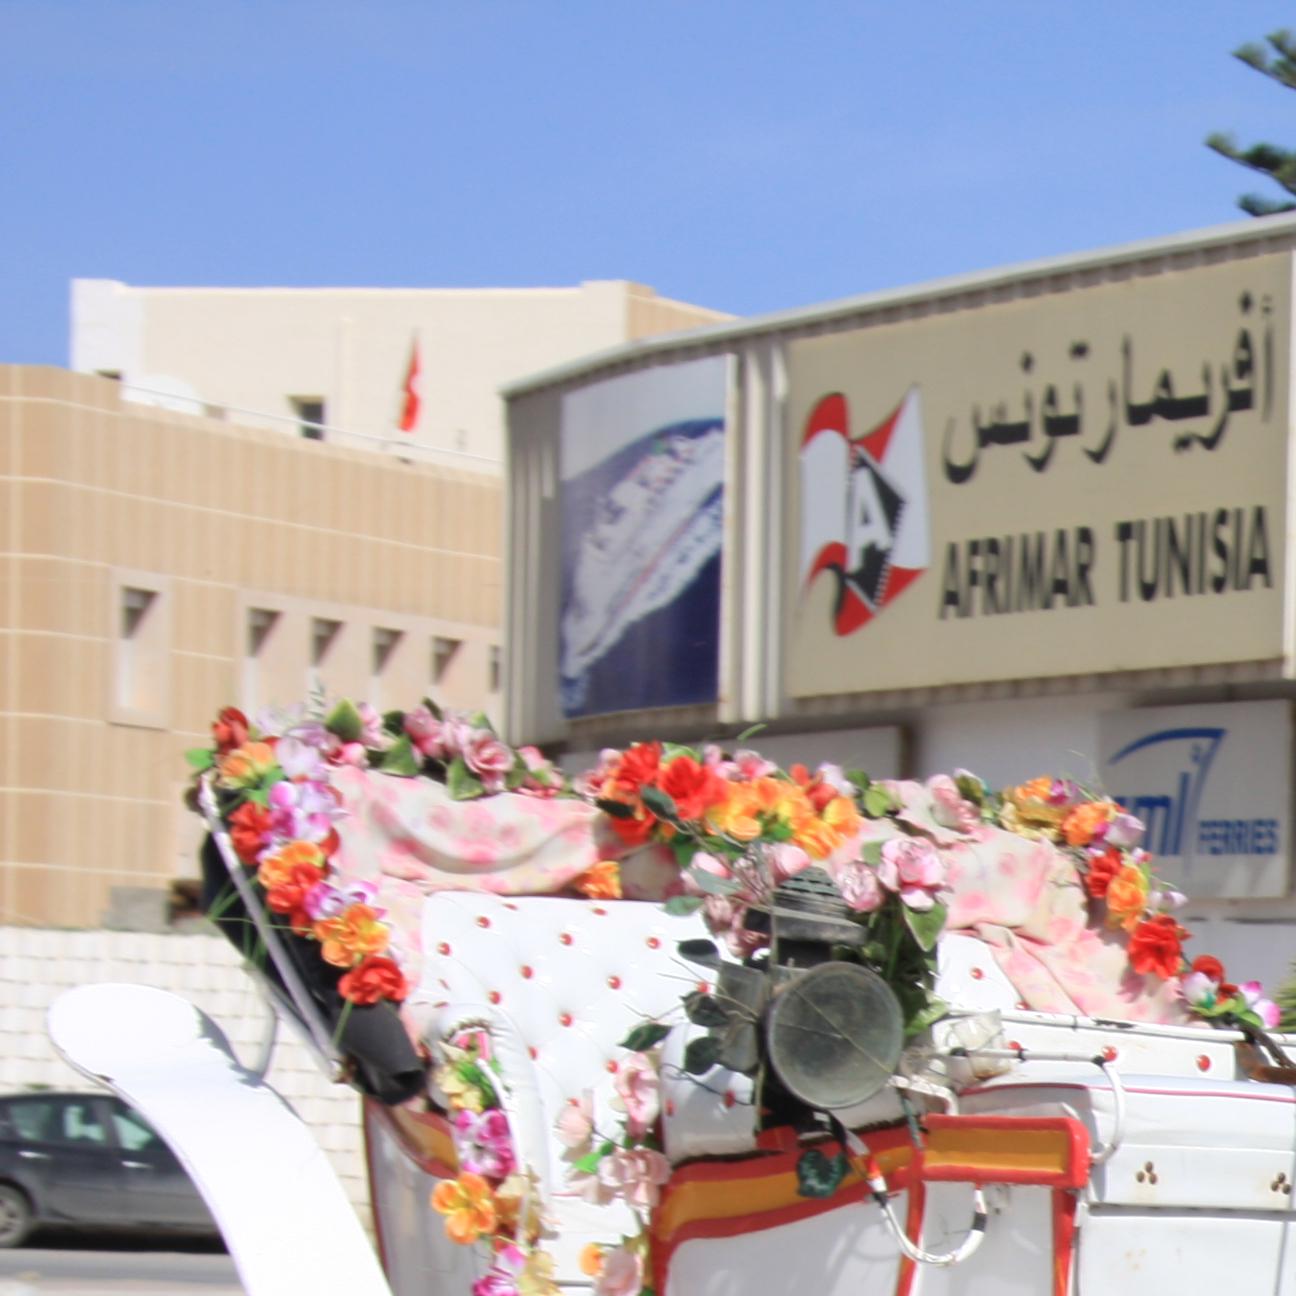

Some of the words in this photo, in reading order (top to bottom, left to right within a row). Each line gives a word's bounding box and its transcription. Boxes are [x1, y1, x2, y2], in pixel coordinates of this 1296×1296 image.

[942, 340, 1092, 485] تونس
[1082, 291, 1273, 465] أفريمار
[938, 525, 1096, 620] AFRIMAR
[1114, 505, 1273, 602] TUNISIA
[1199, 819, 1279, 856] FERRIES
